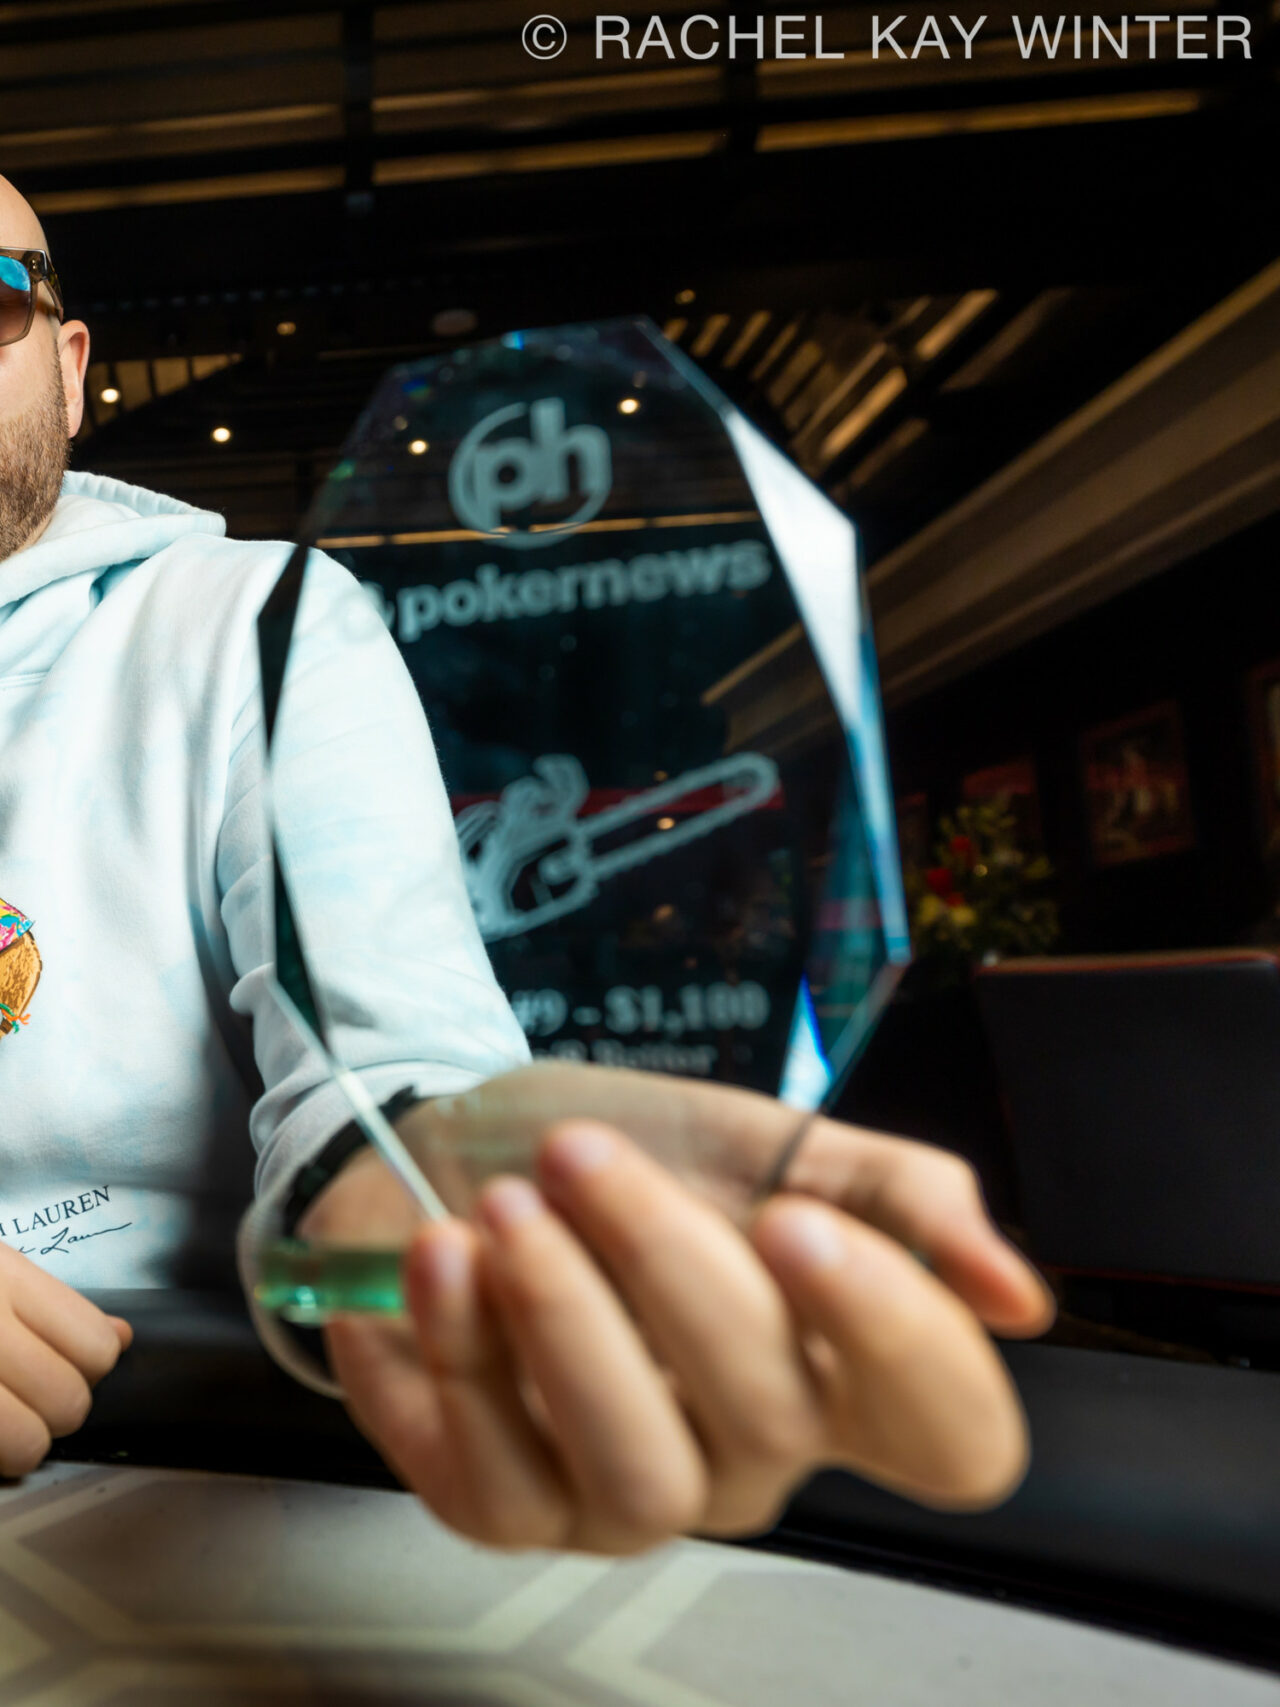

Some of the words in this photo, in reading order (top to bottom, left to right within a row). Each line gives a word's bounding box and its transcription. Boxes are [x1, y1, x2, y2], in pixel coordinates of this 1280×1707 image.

[396, 539, 772, 644] pokernews
[605, 981, 768, 1038] $1,100
[12, 1184, 112, 1235] LAUREN
